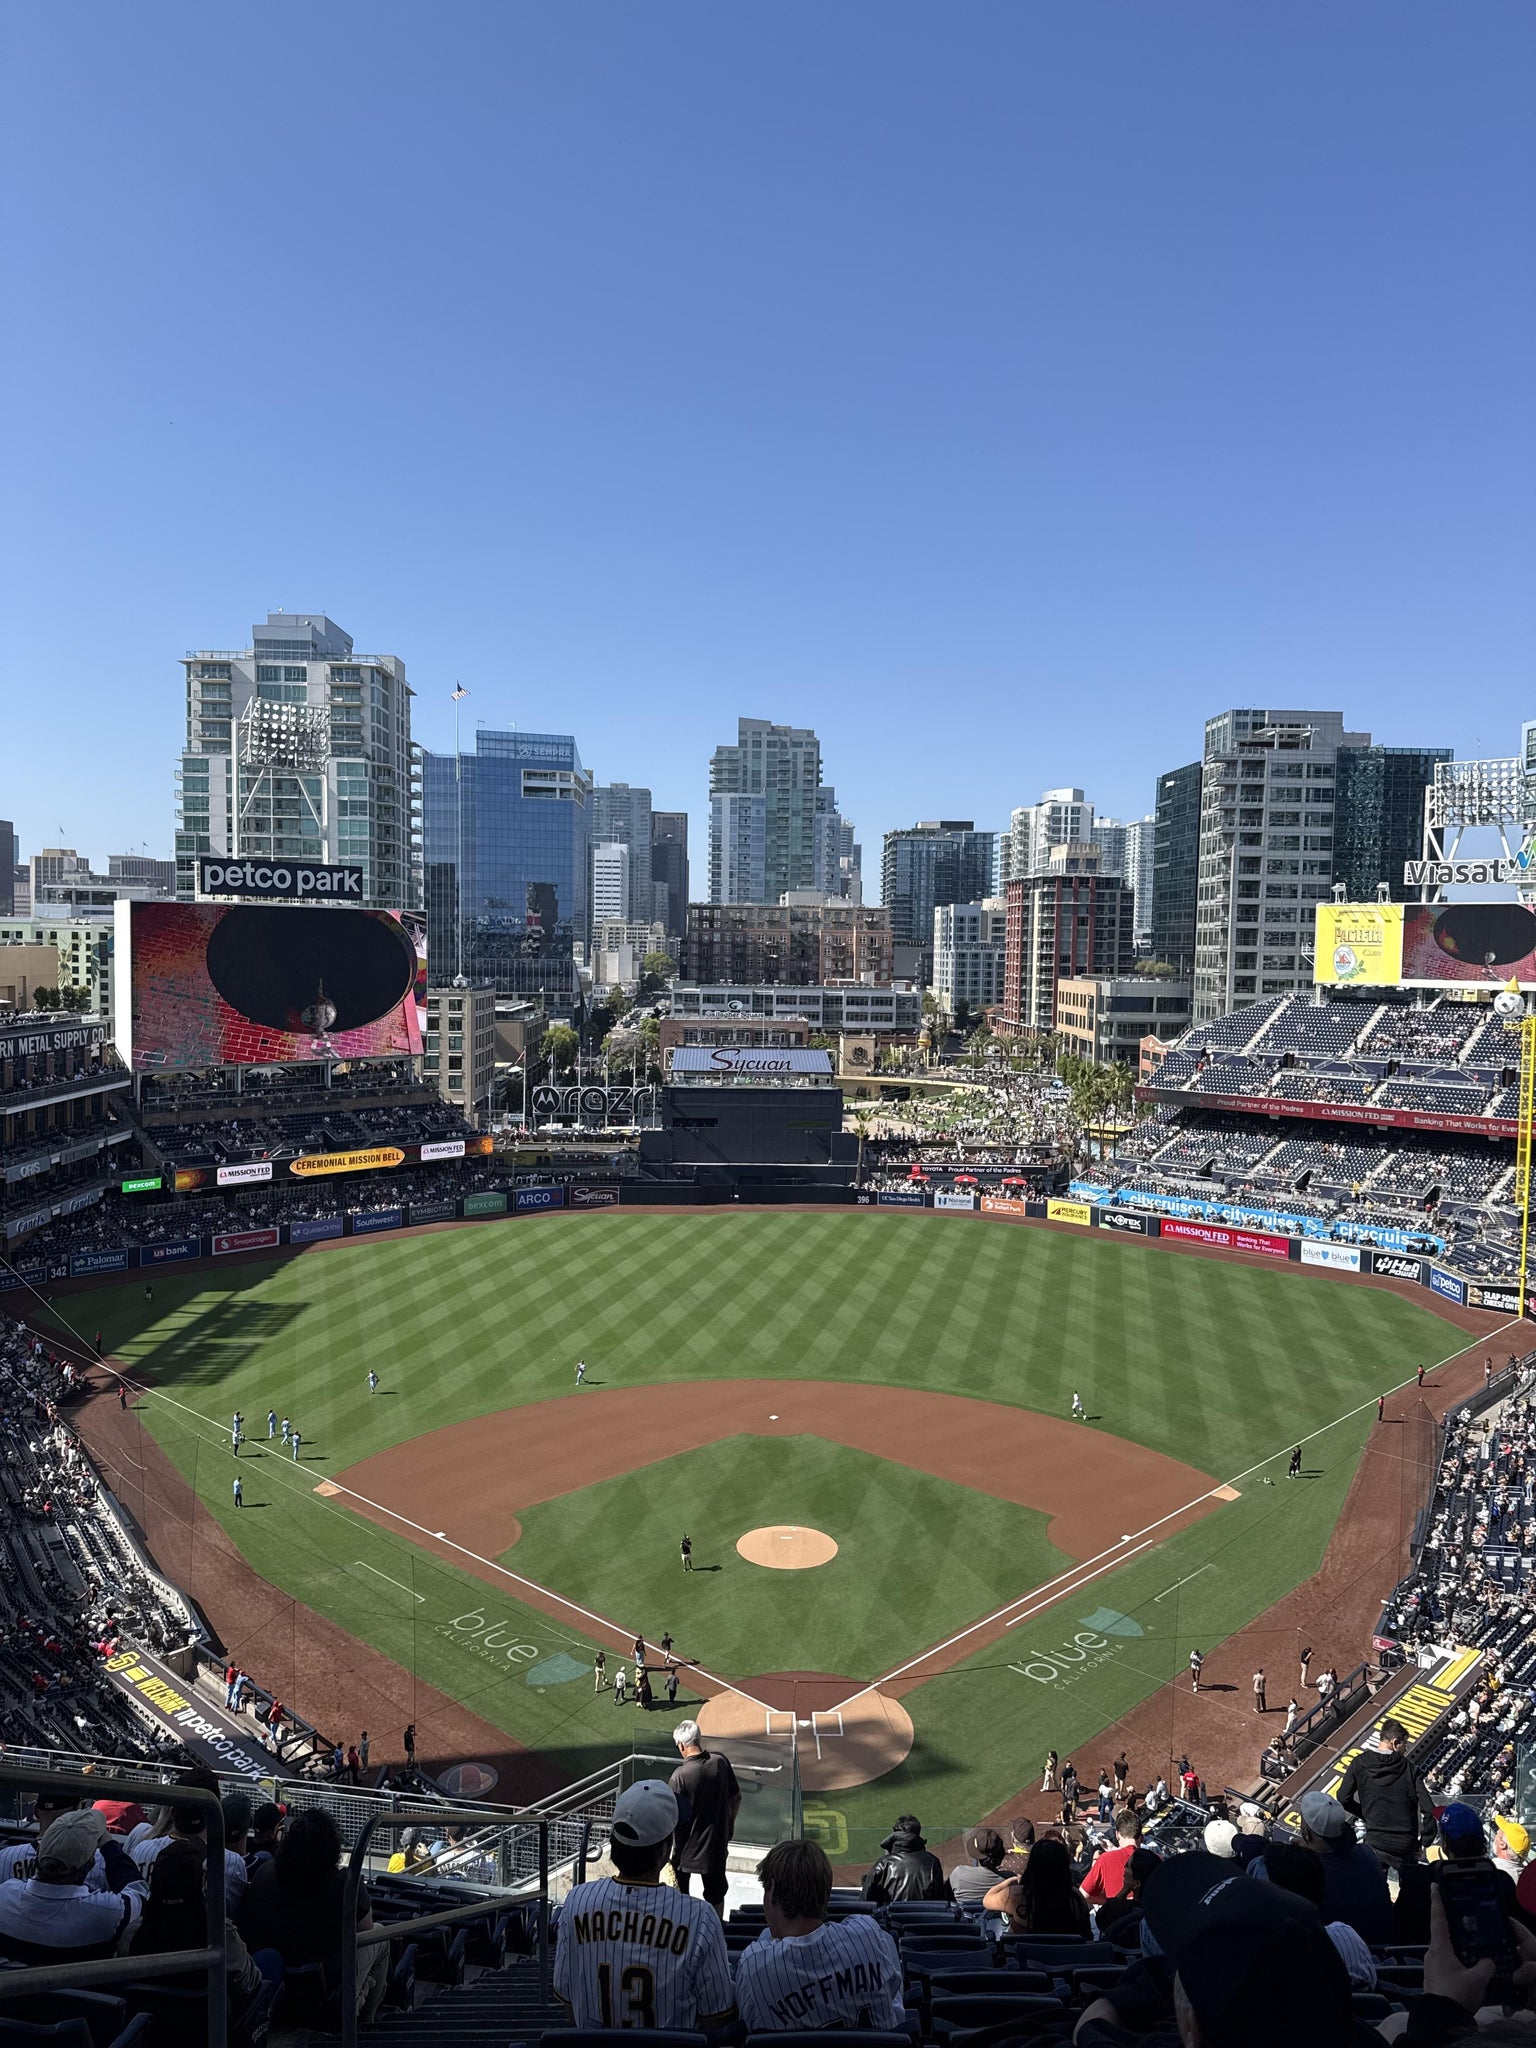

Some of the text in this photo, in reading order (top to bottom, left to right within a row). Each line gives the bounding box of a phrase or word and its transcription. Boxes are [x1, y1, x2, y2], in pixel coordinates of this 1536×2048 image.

[204, 862, 360, 896] petco park
[1408, 859, 1505, 884] Viasat
[705, 1010, 764, 1019] Gallagher Square
[18, 1035, 52, 1056] METAL
[54, 1029, 88, 1050] SUPPLY
[92, 1028, 106, 1043] CO.
[710, 1047, 794, 1076] Sycuan
[564, 1086, 652, 1115] razr
[1217, 1099, 1236, 1108] Proud
[1236, 1100, 1262, 1109] Partner
[1262, 1102, 1268, 1110] of
[1281, 1104, 1304, 1113] Padres
[1330, 1109, 1364, 1120] MISSION
[1364, 1112, 1380, 1120] FED
[1414, 1117, 1444, 1128] Banking
[1445, 1119, 1462, 1128] That
[1464, 1121, 1487, 1130] Works
[1488, 1124, 1500, 1132] for
[453, 1144, 464, 1152] FED
[296, 1153, 400, 1170] CEREMONIAL MISSION BELL
[228, 1168, 257, 1178] MISSION
[257, 1167, 270, 1175] FED
[518, 1193, 550, 1205] ARCO
[574, 1188, 618, 1203] Sycuan
[857, 1196, 870, 1204] 396
[1061, 1206, 1088, 1216] MERCURY
[356, 1216, 394, 1228] Southwest
[233, 1234, 272, 1246] Snapdragon
[1176, 1225, 1230, 1242] MISSION FED
[1236, 1236, 1258, 1244] Banking
[1340, 1225, 1418, 1246] citycruis
[153, 1245, 188, 1258] us bank
[1302, 1248, 1321, 1257] blue
[1332, 1252, 1350, 1262] blue
[87, 1254, 125, 1266] Palomar
[50, 1266, 68, 1278] 342
[1388, 1268, 1418, 1279] POWER
[1440, 1276, 1460, 1294] petco
[1484, 1291, 1502, 1300] SLAP
[1484, 1298, 1504, 1309] CHEESE
[1504, 1302, 1514, 1310] ON
[448, 1608, 539, 1663] blue
[434, 1625, 512, 1672] CALIFORNIA
[1008, 1632, 1108, 1684] blue
[1054, 1644, 1126, 1690] CALIFORNIA
[134, 1676, 191, 1715] WELCOME
[178, 1717, 234, 1752] petco
[218, 1748, 269, 1782] park
[574, 1910, 690, 1956] MACHADO
[597, 1962, 656, 2028] 13
[770, 1962, 883, 2025] HOFFMAN
